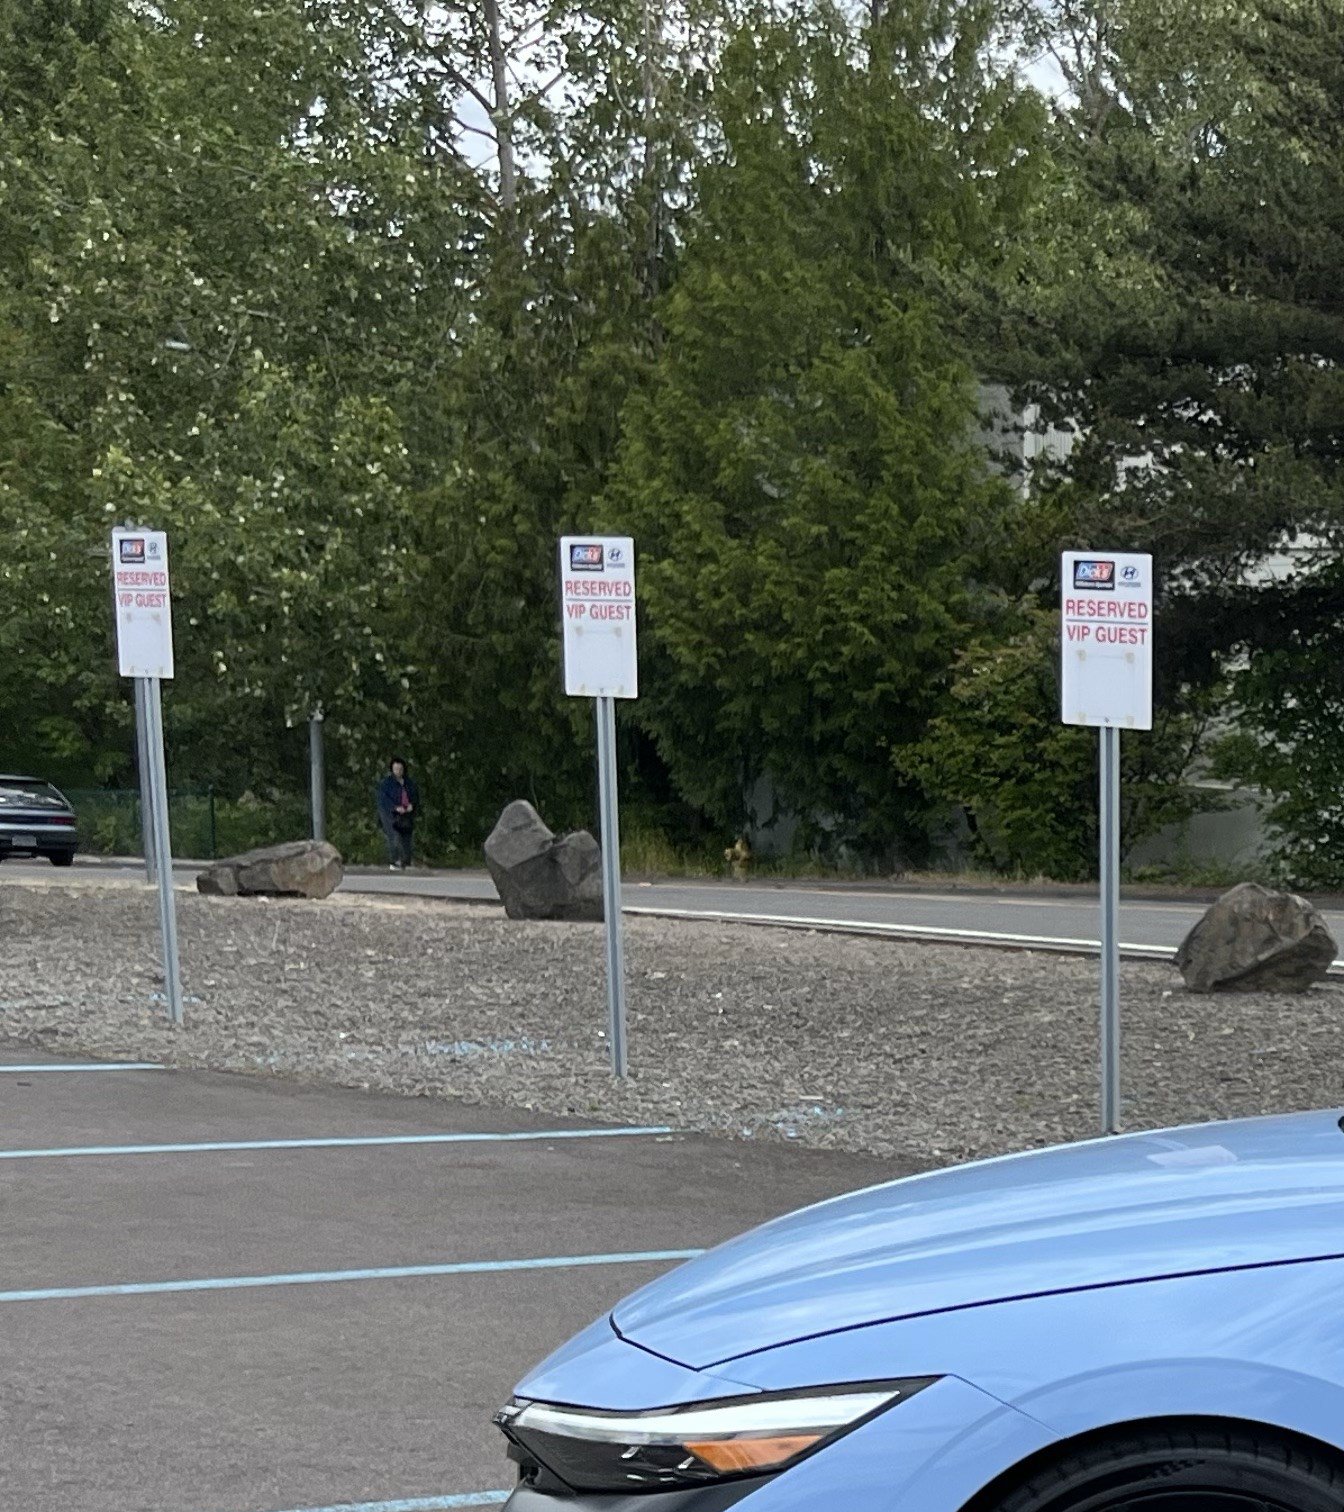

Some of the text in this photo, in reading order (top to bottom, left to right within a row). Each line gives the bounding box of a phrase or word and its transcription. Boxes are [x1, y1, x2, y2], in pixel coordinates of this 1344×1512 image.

[565, 580, 632, 596] RESERVED
[566, 603, 632, 620] VIP GUEST
[1066, 599, 1148, 618] RESERVED
[1066, 625, 1148, 645] VIP GUEST
